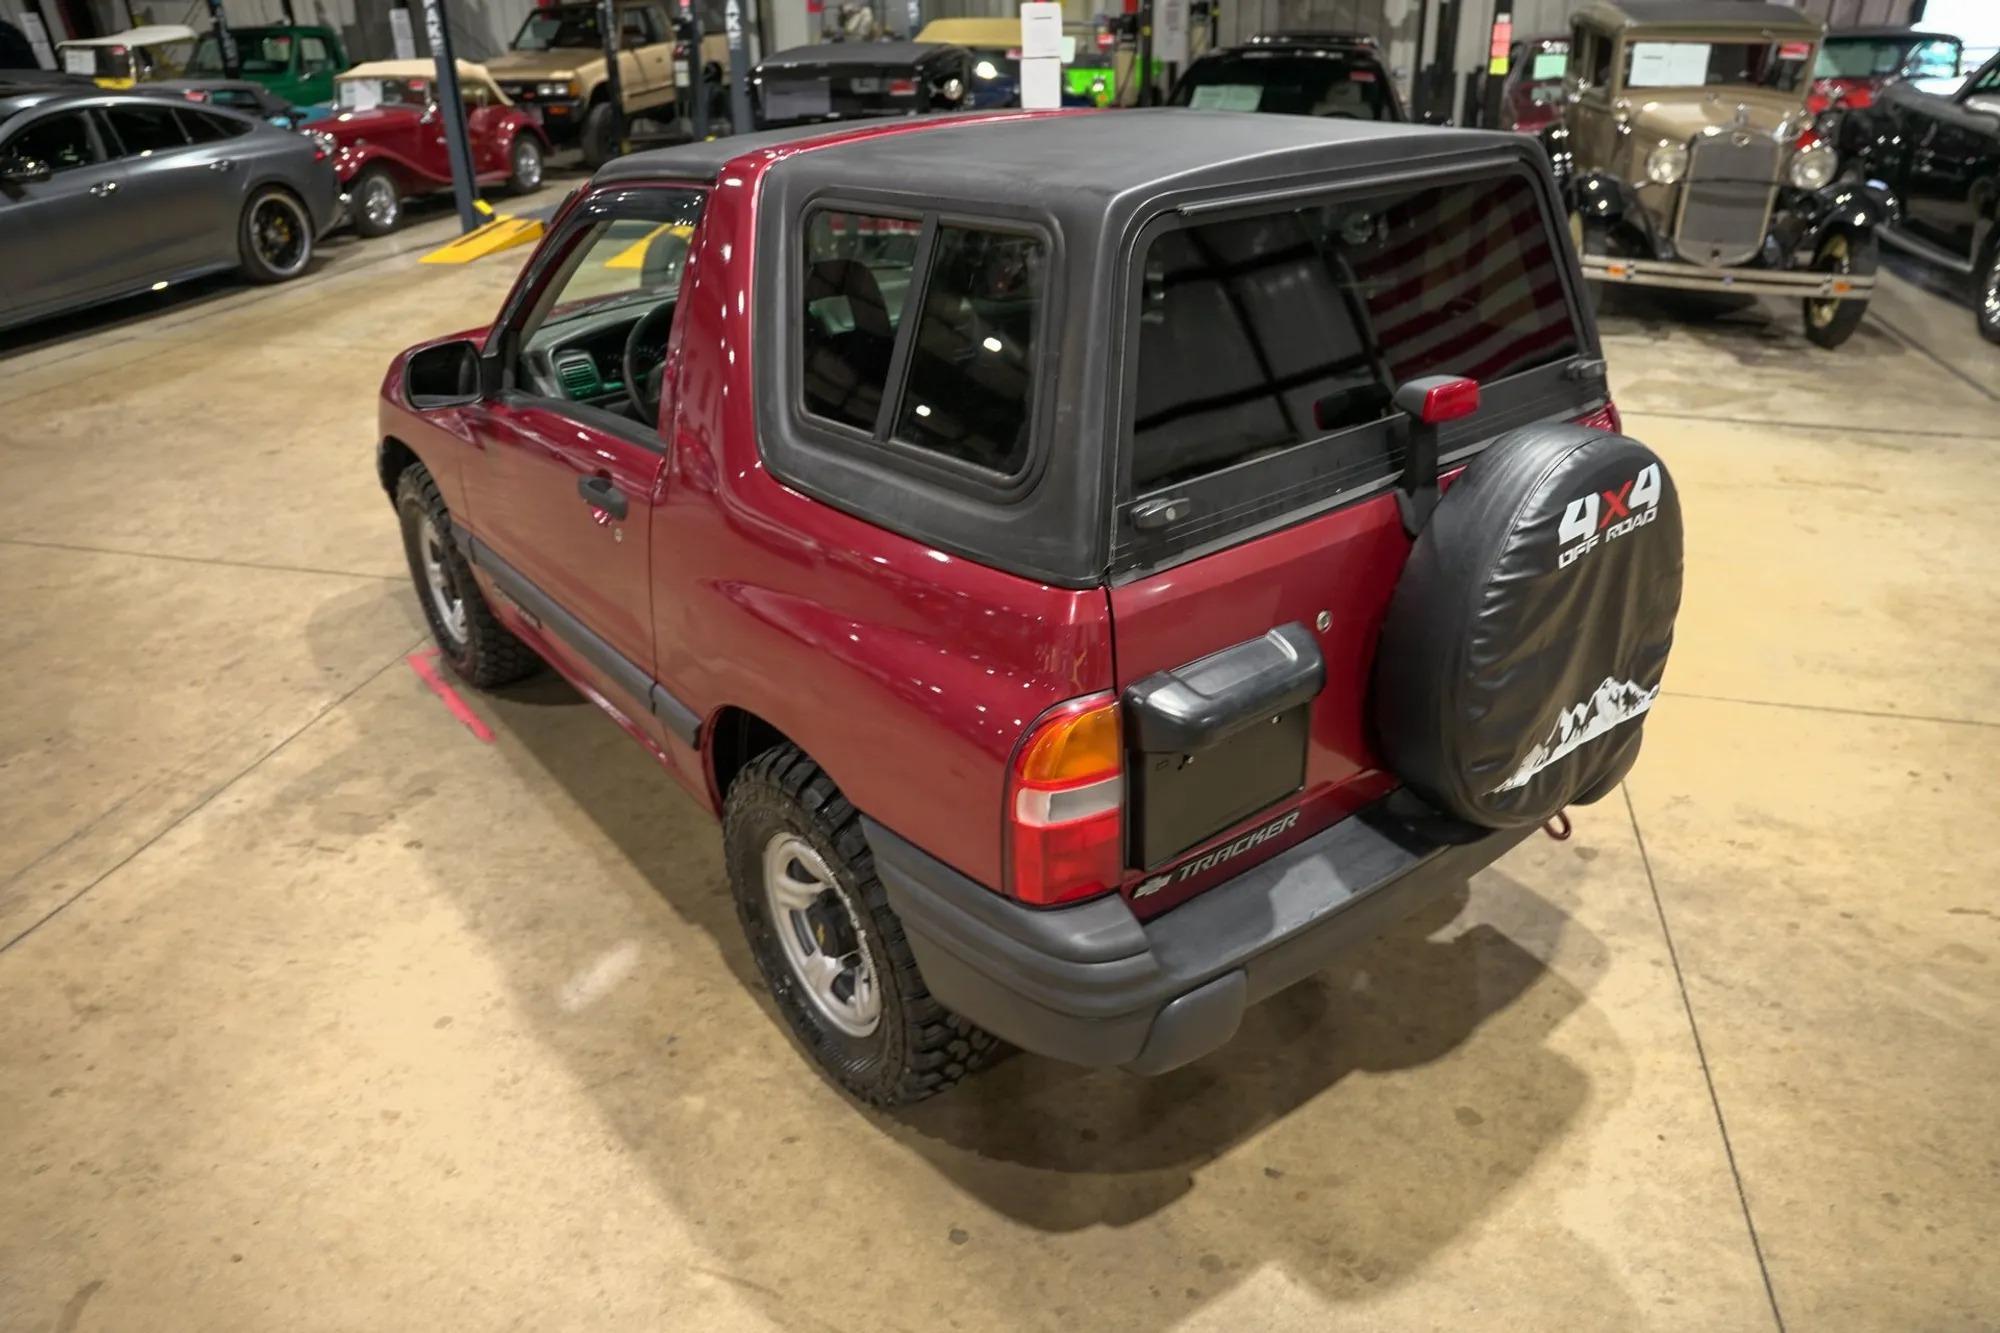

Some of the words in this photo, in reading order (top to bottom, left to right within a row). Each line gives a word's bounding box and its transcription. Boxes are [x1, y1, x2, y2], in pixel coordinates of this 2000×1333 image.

[1558, 533, 1600, 569] OFF
[1605, 506, 1658, 543] ROAD
[1179, 811, 1300, 881] TRACKER
